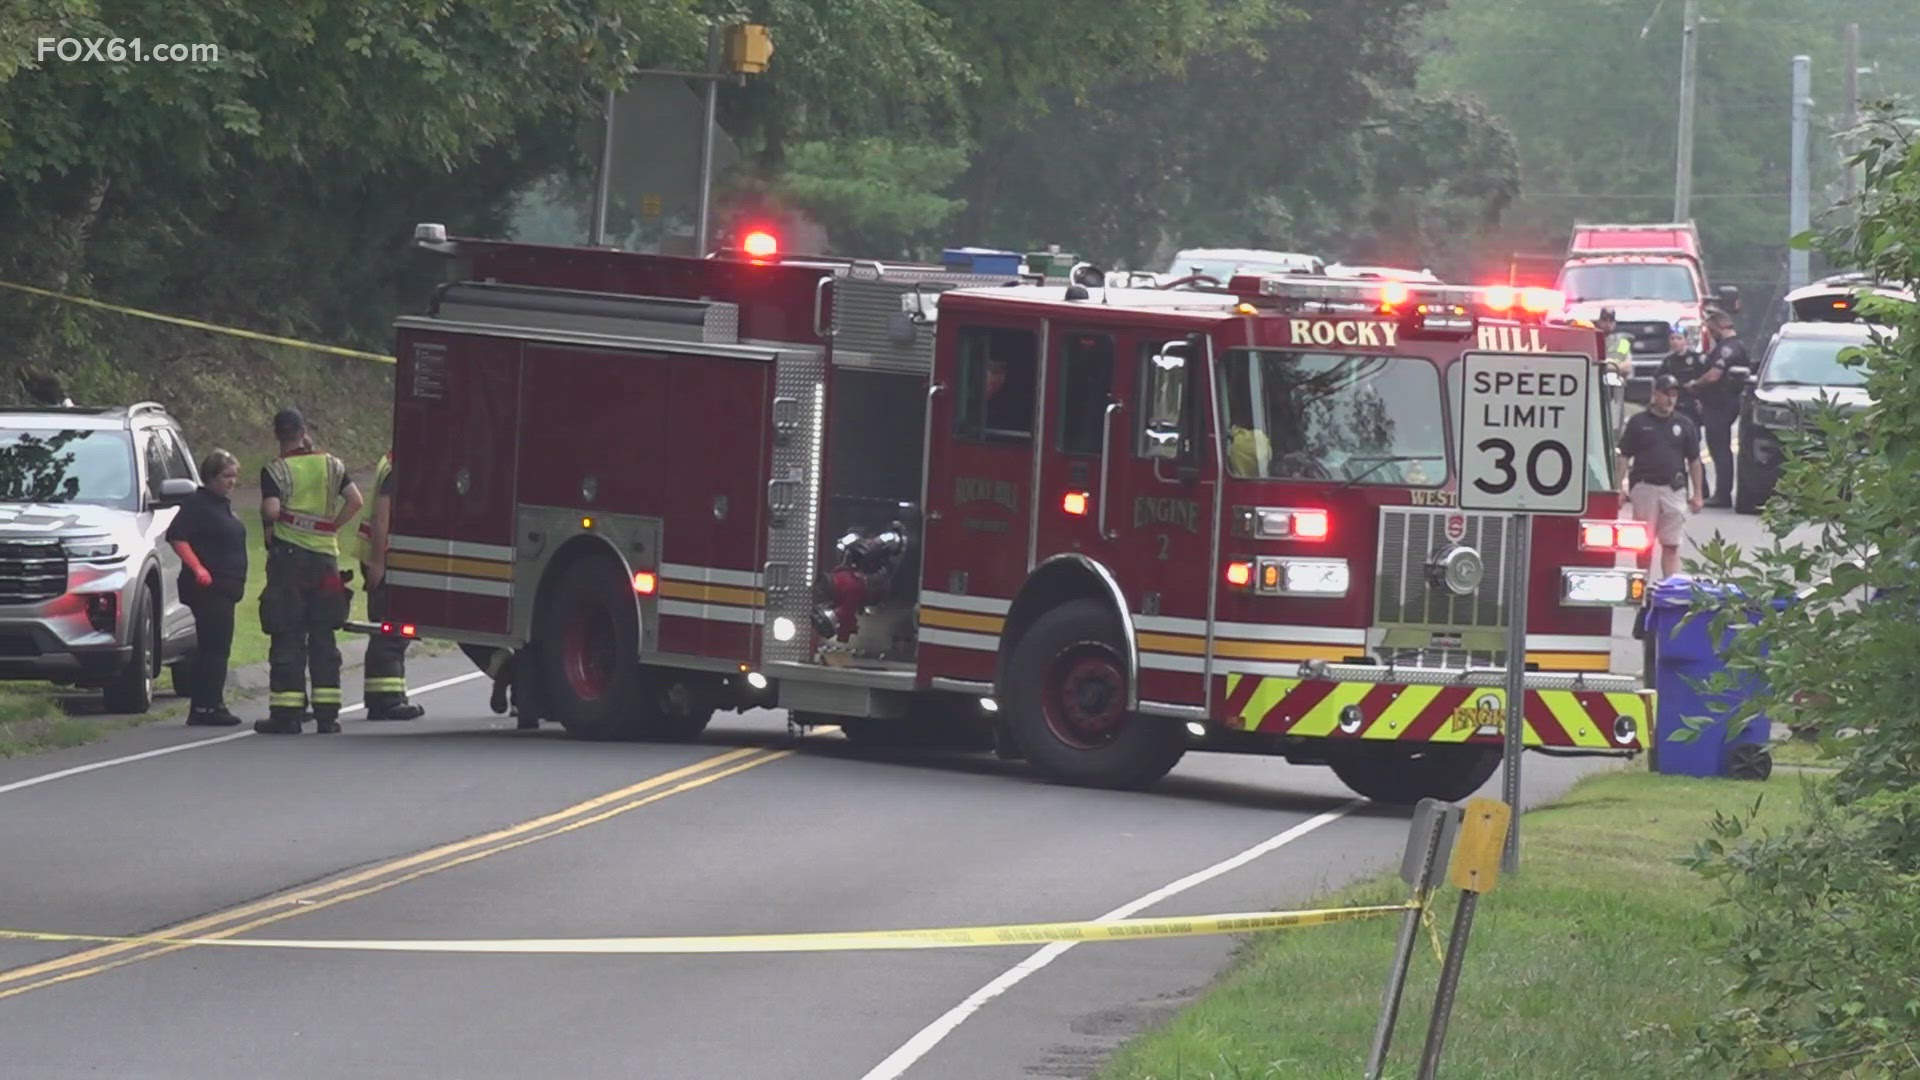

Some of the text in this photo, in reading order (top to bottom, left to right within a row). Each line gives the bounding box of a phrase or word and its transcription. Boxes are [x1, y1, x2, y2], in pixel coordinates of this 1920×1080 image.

[1290, 319, 1547, 352] ROCKY HILL
[1473, 371, 1578, 396] SPEED
[1484, 404, 1565, 428] LIMIT
[1473, 438, 1572, 496] 30
[1133, 496, 1199, 533] ENGINE
[1156, 533, 1170, 561] 2
